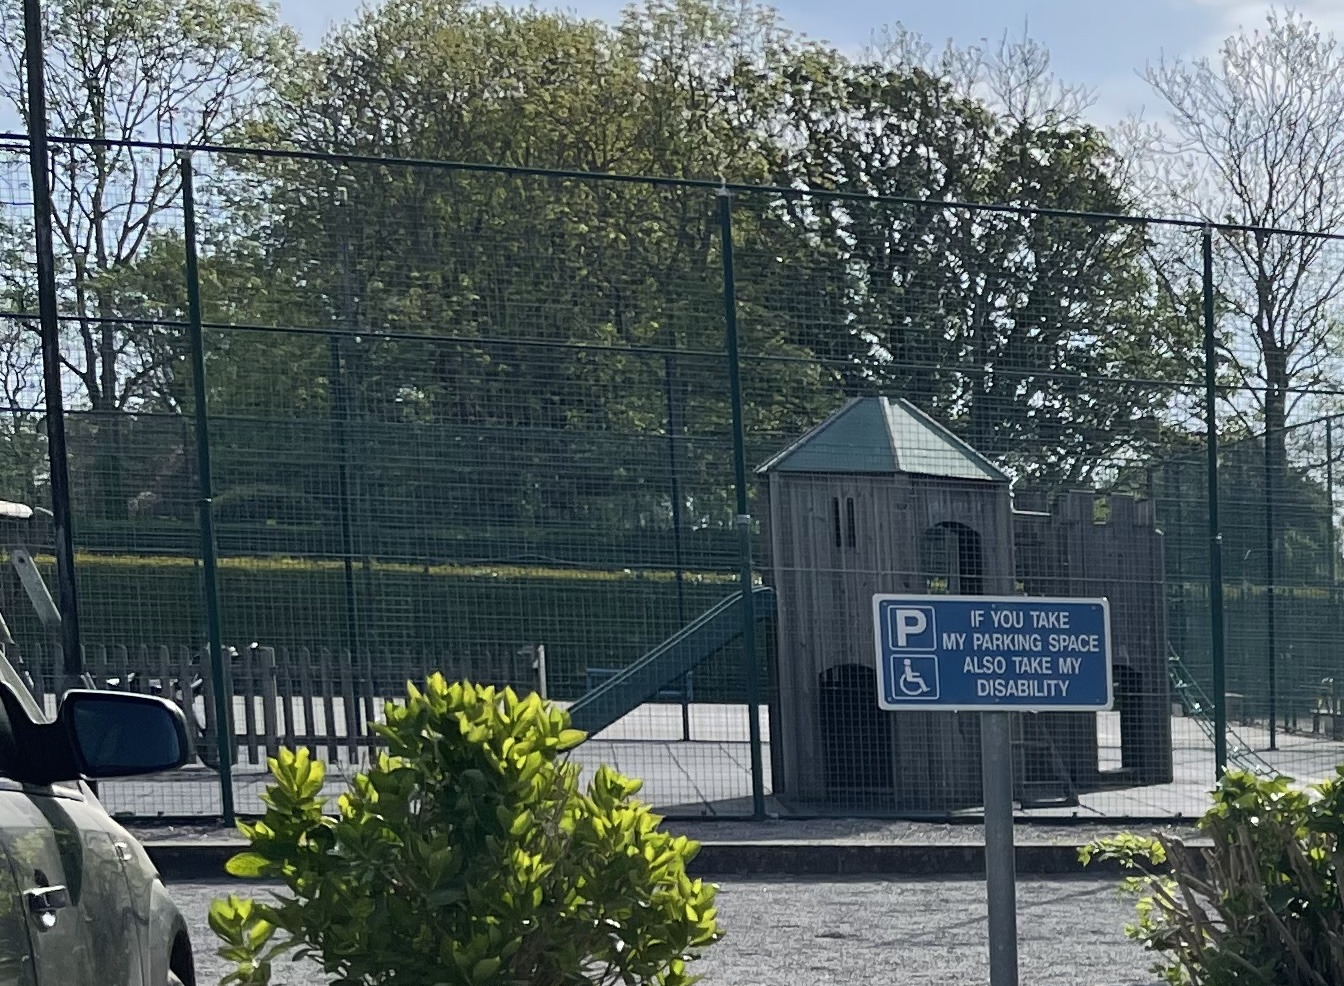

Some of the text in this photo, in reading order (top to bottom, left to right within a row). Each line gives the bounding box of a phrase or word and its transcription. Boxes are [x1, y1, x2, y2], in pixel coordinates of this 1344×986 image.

[896, 609, 927, 647] P
[970, 610, 1070, 629] IF YOU TAKE
[943, 633, 1099, 652] MY PARKING SPACE
[963, 656, 1082, 675] ALSO TAKE MY
[977, 679, 1070, 697] DISABILITY
